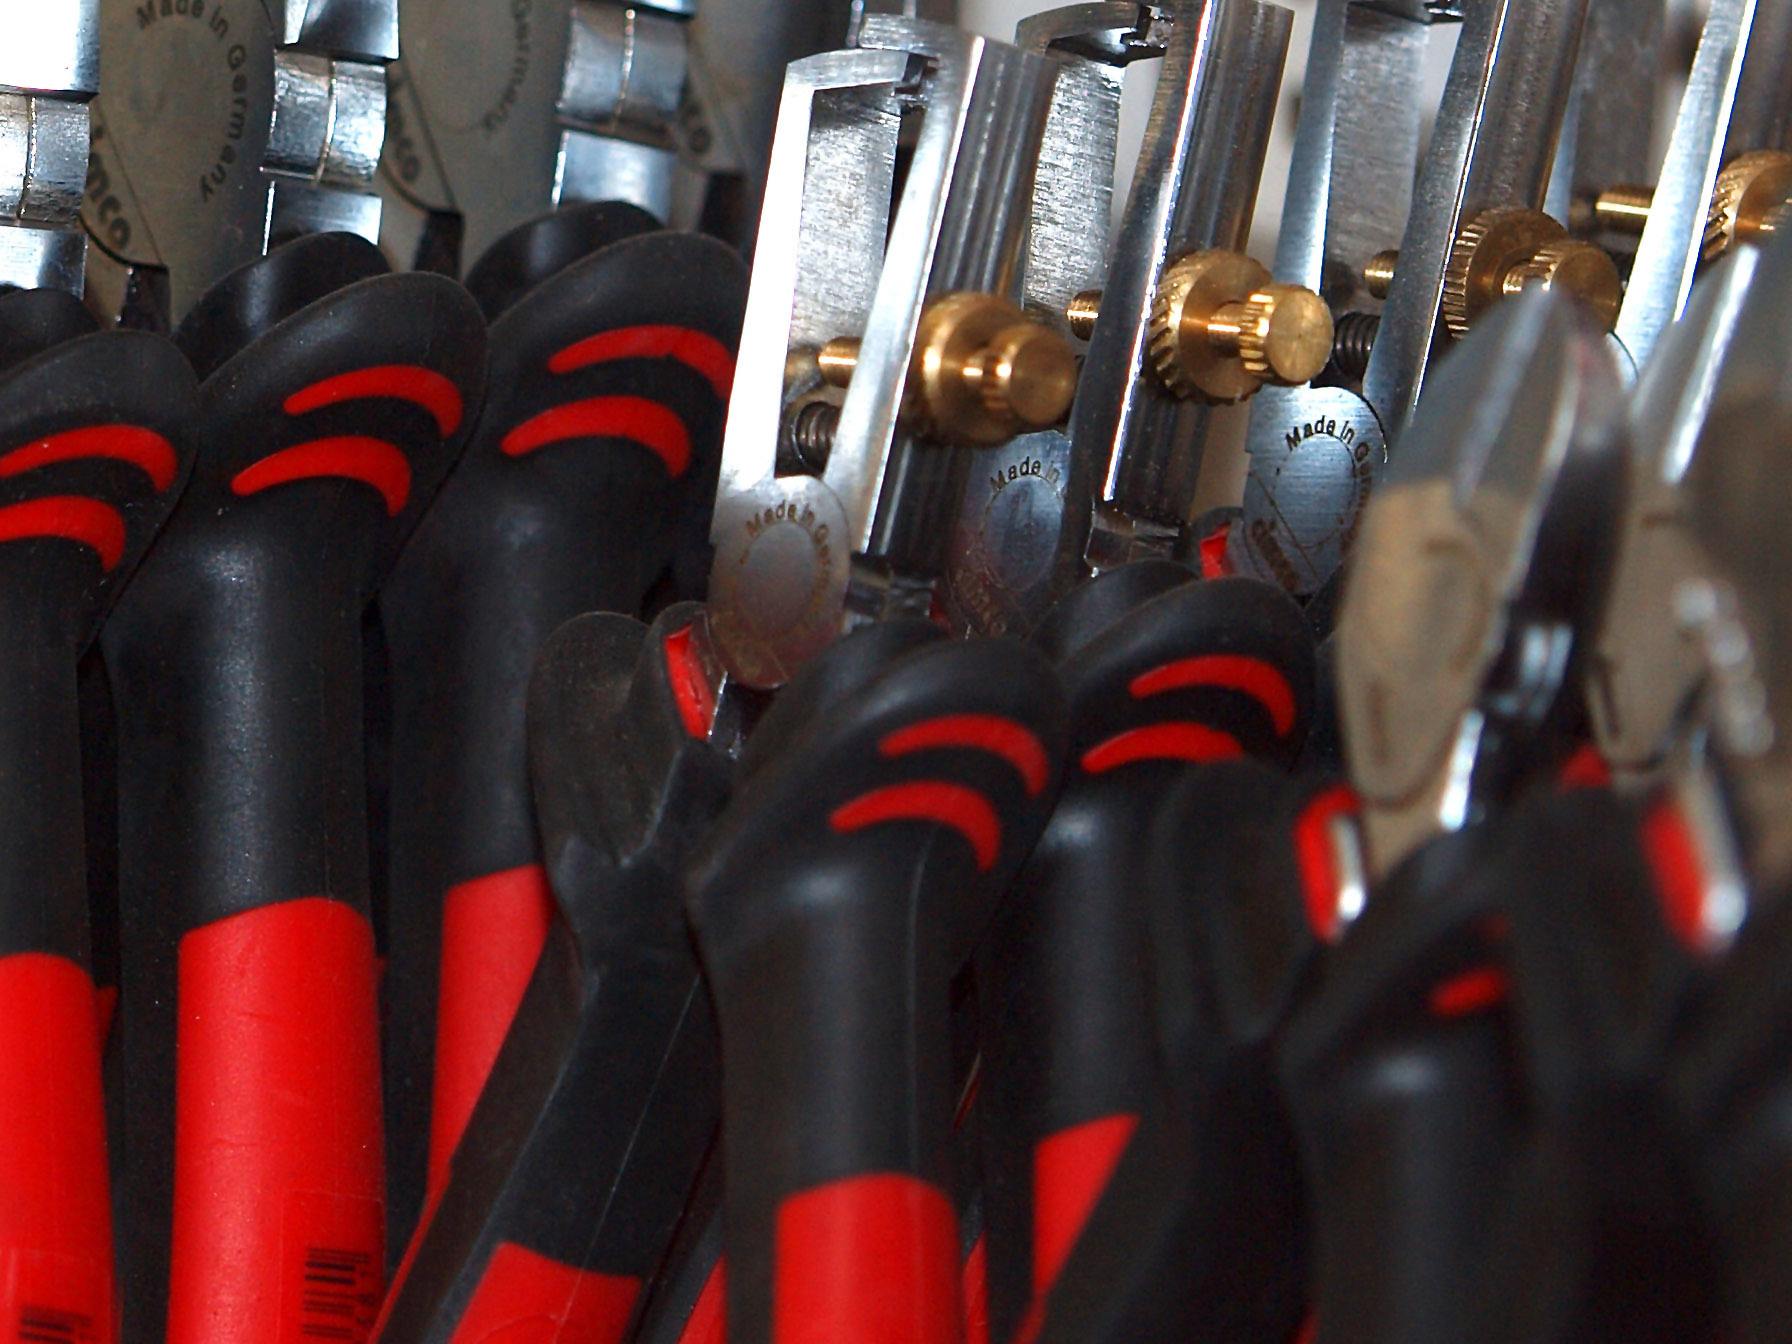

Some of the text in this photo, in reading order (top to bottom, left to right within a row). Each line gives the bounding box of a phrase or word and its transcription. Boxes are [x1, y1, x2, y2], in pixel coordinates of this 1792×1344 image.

[209, 5, 229, 40] in
[199, 43, 248, 204] Germany
[1285, 414, 1337, 452] Made
[1339, 419, 1357, 446] in
[989, 455, 1062, 493] Made in
